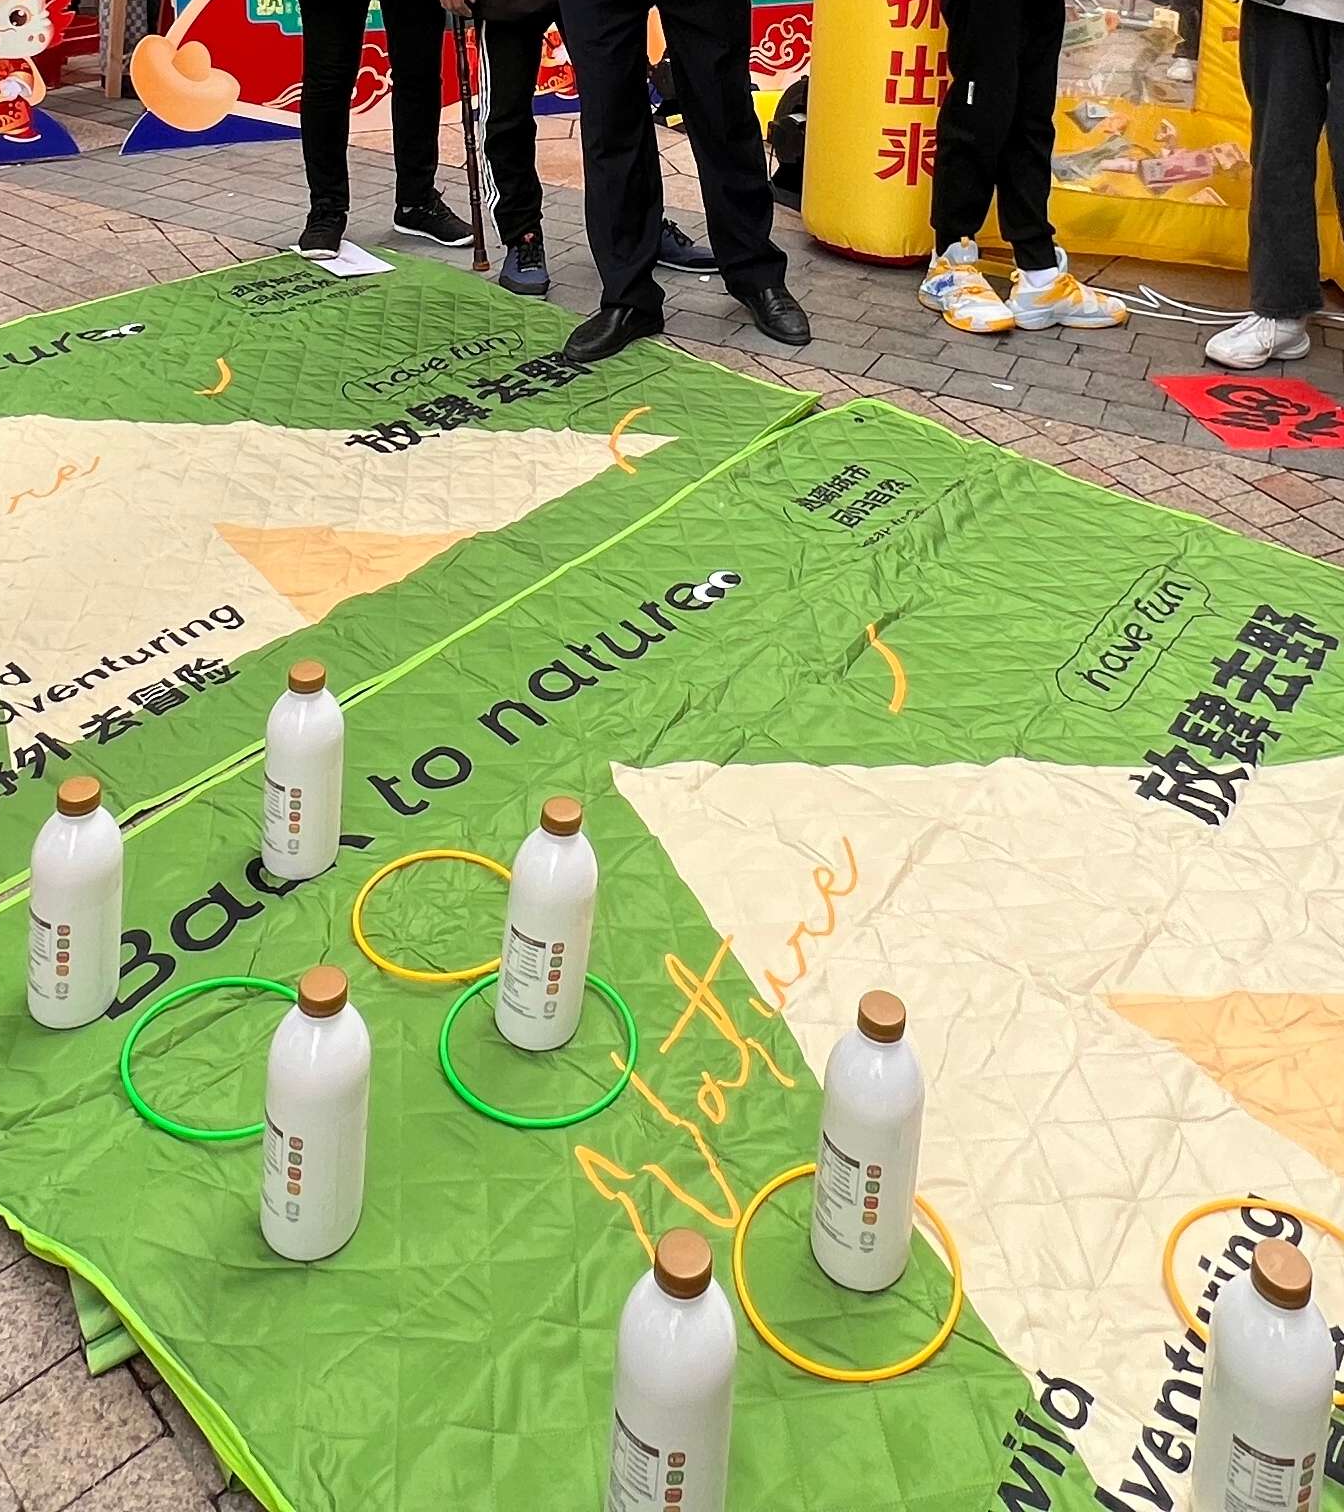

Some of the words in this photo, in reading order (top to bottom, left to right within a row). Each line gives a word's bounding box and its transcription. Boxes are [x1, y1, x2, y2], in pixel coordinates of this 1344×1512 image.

[363, 355, 450, 394] have
[1074, 622, 1153, 692] have
[1133, 579, 1192, 624] fun
[367, 744, 473, 816] to
[478, 580, 716, 747] nature
